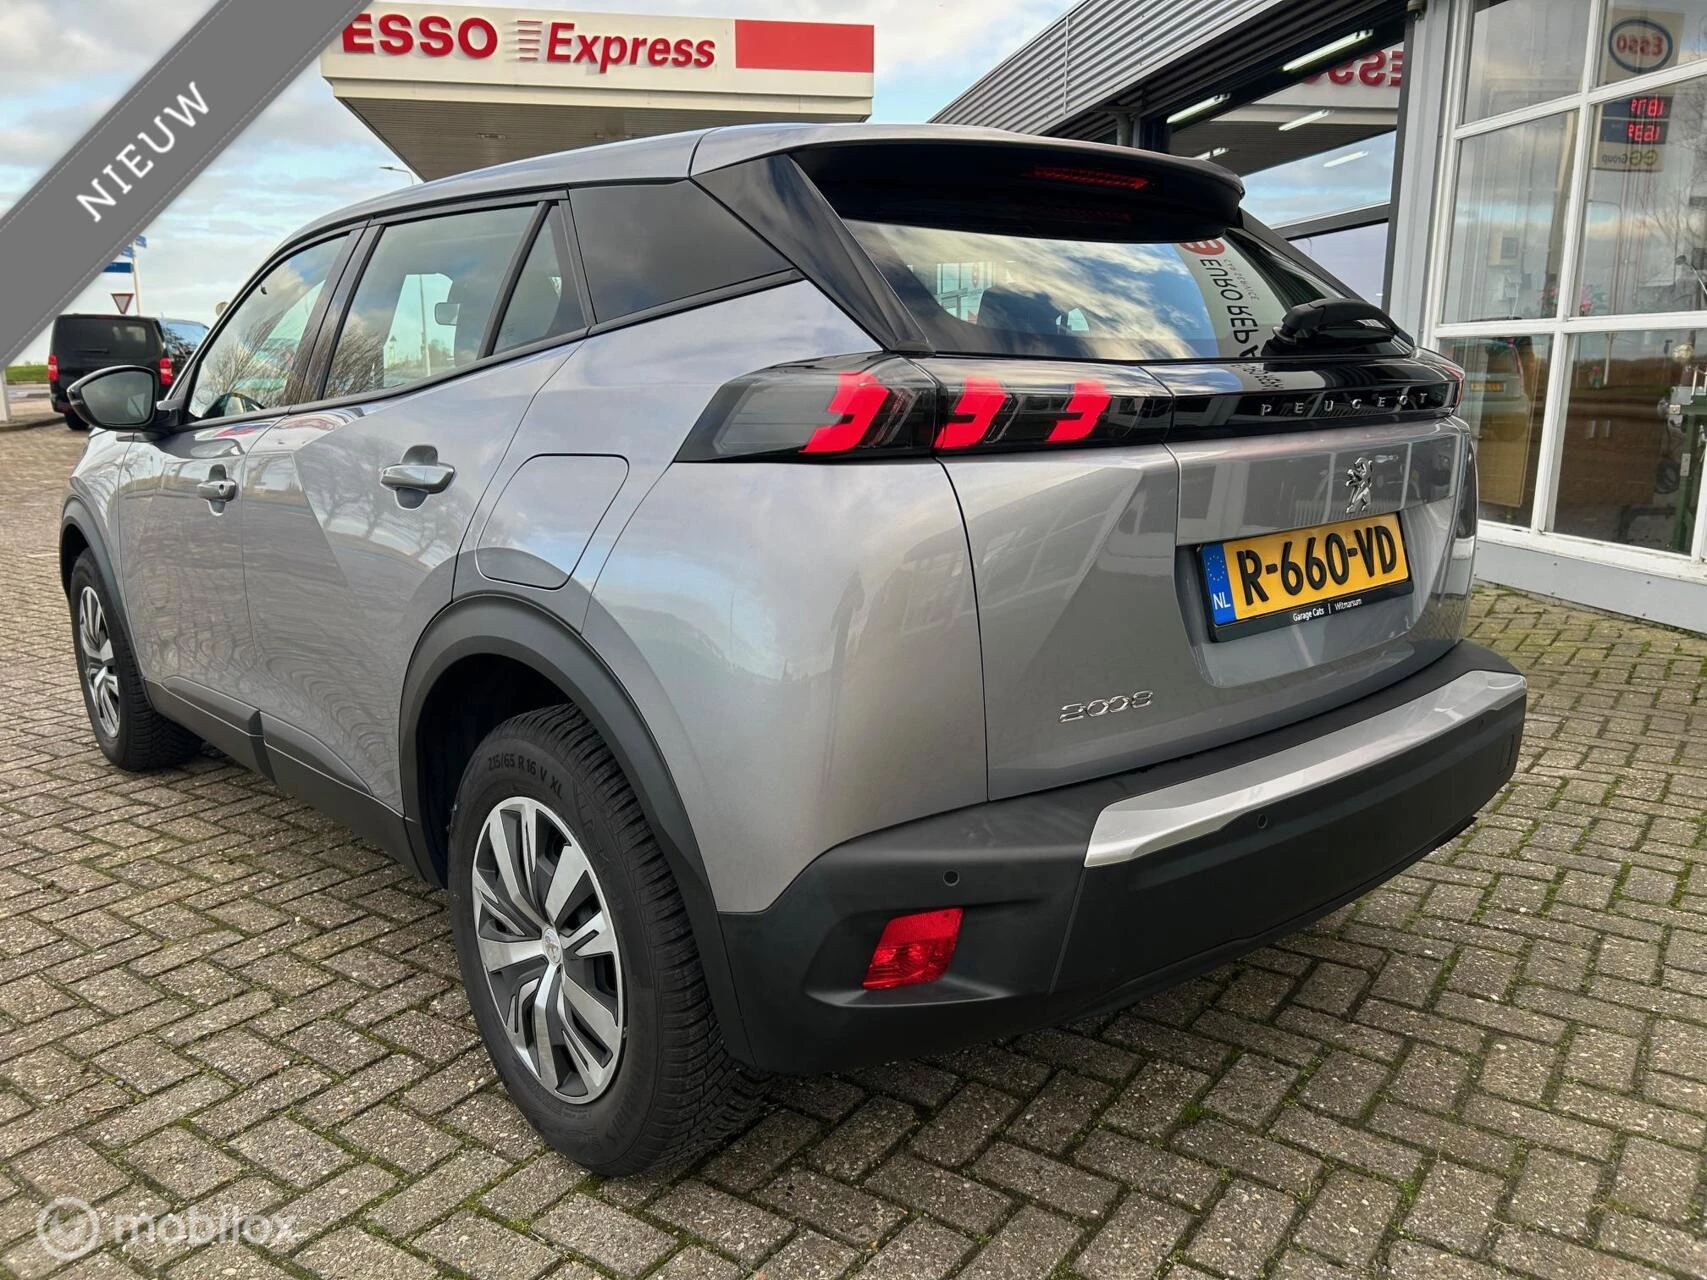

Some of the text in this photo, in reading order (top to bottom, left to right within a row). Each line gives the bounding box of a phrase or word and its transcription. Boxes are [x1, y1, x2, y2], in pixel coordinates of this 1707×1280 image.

[342, 13, 716, 74] ESSO Express
[1261, 392, 1428, 416] PEUGEOT
[1236, 525, 1397, 606] R-660-VD
[1212, 591, 1231, 611] NL
[1293, 610, 1313, 622] Garage
[1312, 607, 1325, 617] Cats
[1060, 690, 1153, 723] 2008
